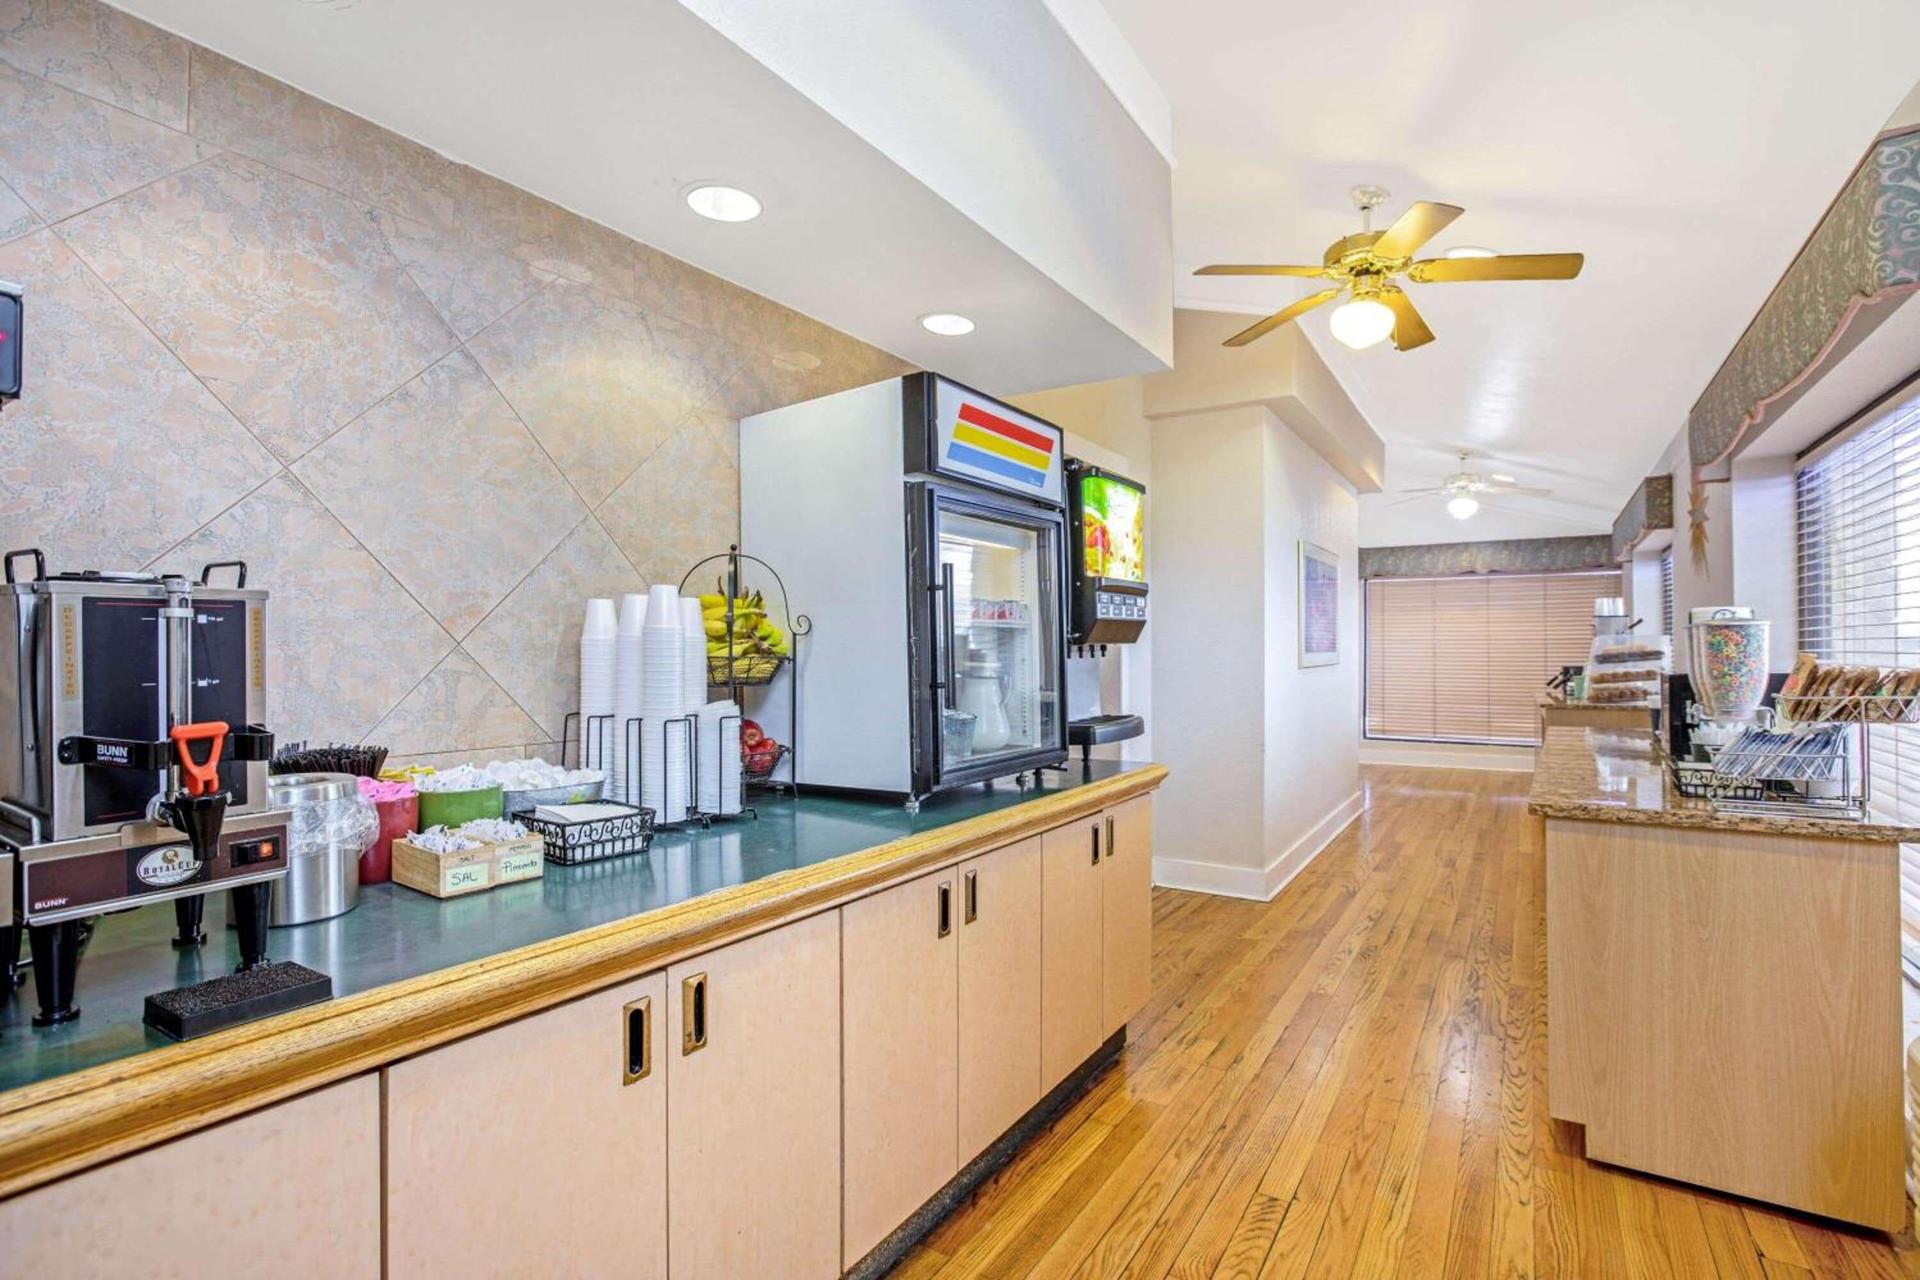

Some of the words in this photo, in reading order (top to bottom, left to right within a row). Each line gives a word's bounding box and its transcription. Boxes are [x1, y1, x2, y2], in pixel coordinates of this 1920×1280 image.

[97, 744, 128, 757] BUNN
[451, 872, 478, 886] SAL
[34, 898, 66, 909] BUNN
